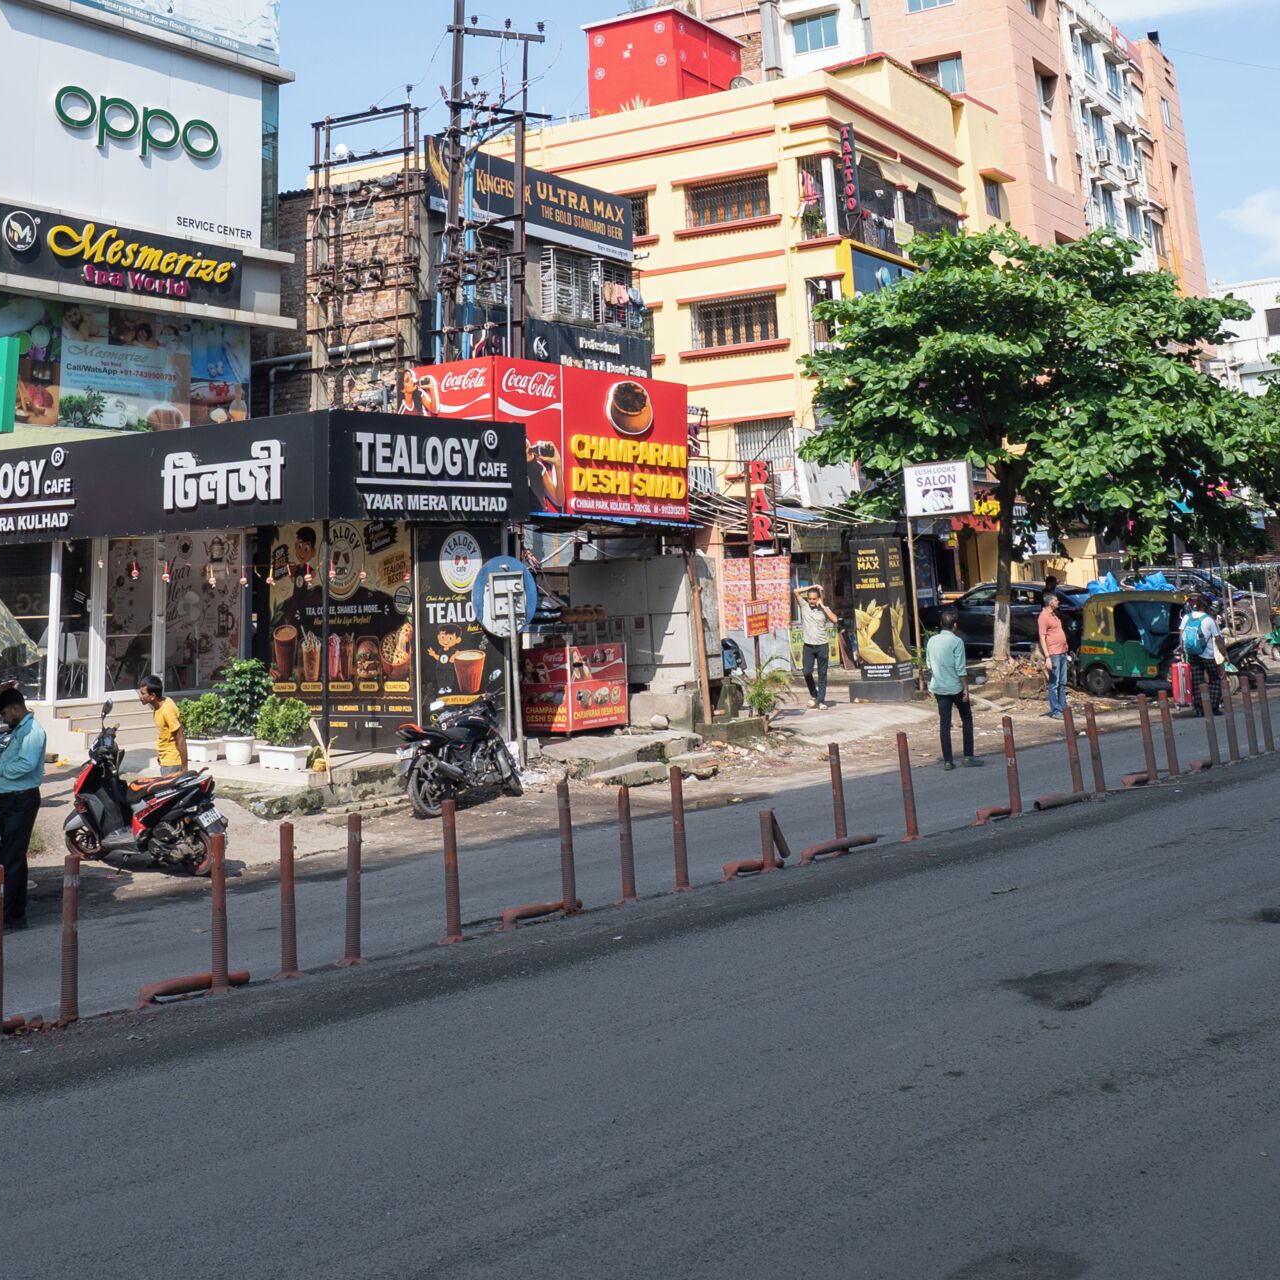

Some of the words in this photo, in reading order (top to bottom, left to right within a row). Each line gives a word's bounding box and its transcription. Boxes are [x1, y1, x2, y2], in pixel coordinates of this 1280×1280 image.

[134, 6, 150, 20] New
[150, 11, 169, 26] Town
[169, 17, 187, 32] Road
[190, 25, 215, 41] Kolkata
[54, 85, 220, 158] oppo
[841, 126, 857, 210] TATTOO
[475, 169, 533, 206] KINGFISR
[536, 180, 590, 214] ULTRA
[593, 198, 625, 224] MAX
[176, 215, 215, 233] SERVICE
[216, 223, 253, 240] CENTER
[540, 204, 554, 219] THE
[554, 208, 572, 226] GOLD
[573, 212, 607, 236] STANDARD
[607, 226, 624, 241] BEER
[47, 221, 235, 284] Mesmerize
[81, 263, 125, 288] Spa
[127, 270, 190, 299] World
[67, 344, 149, 363] Mesmerize
[578, 336, 621, 355] Professional
[66, 363, 118, 375] Call/WatsApp
[440, 367, 486, 391] Coca-Cola
[501, 367, 557, 399] Coca-Cola
[356, 431, 480, 476] TEALOGY
[478, 462, 508, 478] CAFE
[570, 434, 687, 469] CHAMPARAN
[914, 467, 933, 476] LUSH
[932, 465, 956, 474] LOOKS
[916, 473, 957, 488] SALON
[44, 477, 71, 494] CAFE
[571, 466, 631, 496] DESHI
[632, 471, 687, 500] SWAD
[363, 493, 404, 511] YAAR
[407, 494, 448, 512] MERA
[451, 495, 508, 513] KULHAD
[576, 498, 596, 510] CHINAR
[596, 499, 610, 513] PARK,
[609, 501, 631, 513] KOLKATA
[750, 460, 772, 541] BAR
[17, 512, 69, 531] KULHAD
[444, 534, 478, 556] TEALOGY
[857, 561, 880, 570] MAX
[888, 560, 900, 569] MAX
[425, 594, 439, 602] Chai
[306, 607, 317, 616] TEA,
[337, 605, 358, 615] SHAKES
[426, 602, 477, 624] TEALO
[525, 706, 568, 715] CHAMPARAN
[526, 715, 547, 723] DESHI
[547, 714, 568, 723] SWAD
[573, 708, 601, 721] CHAMPARAN
[601, 706, 613, 716] DESHI
[613, 705, 625, 715] SWAD
